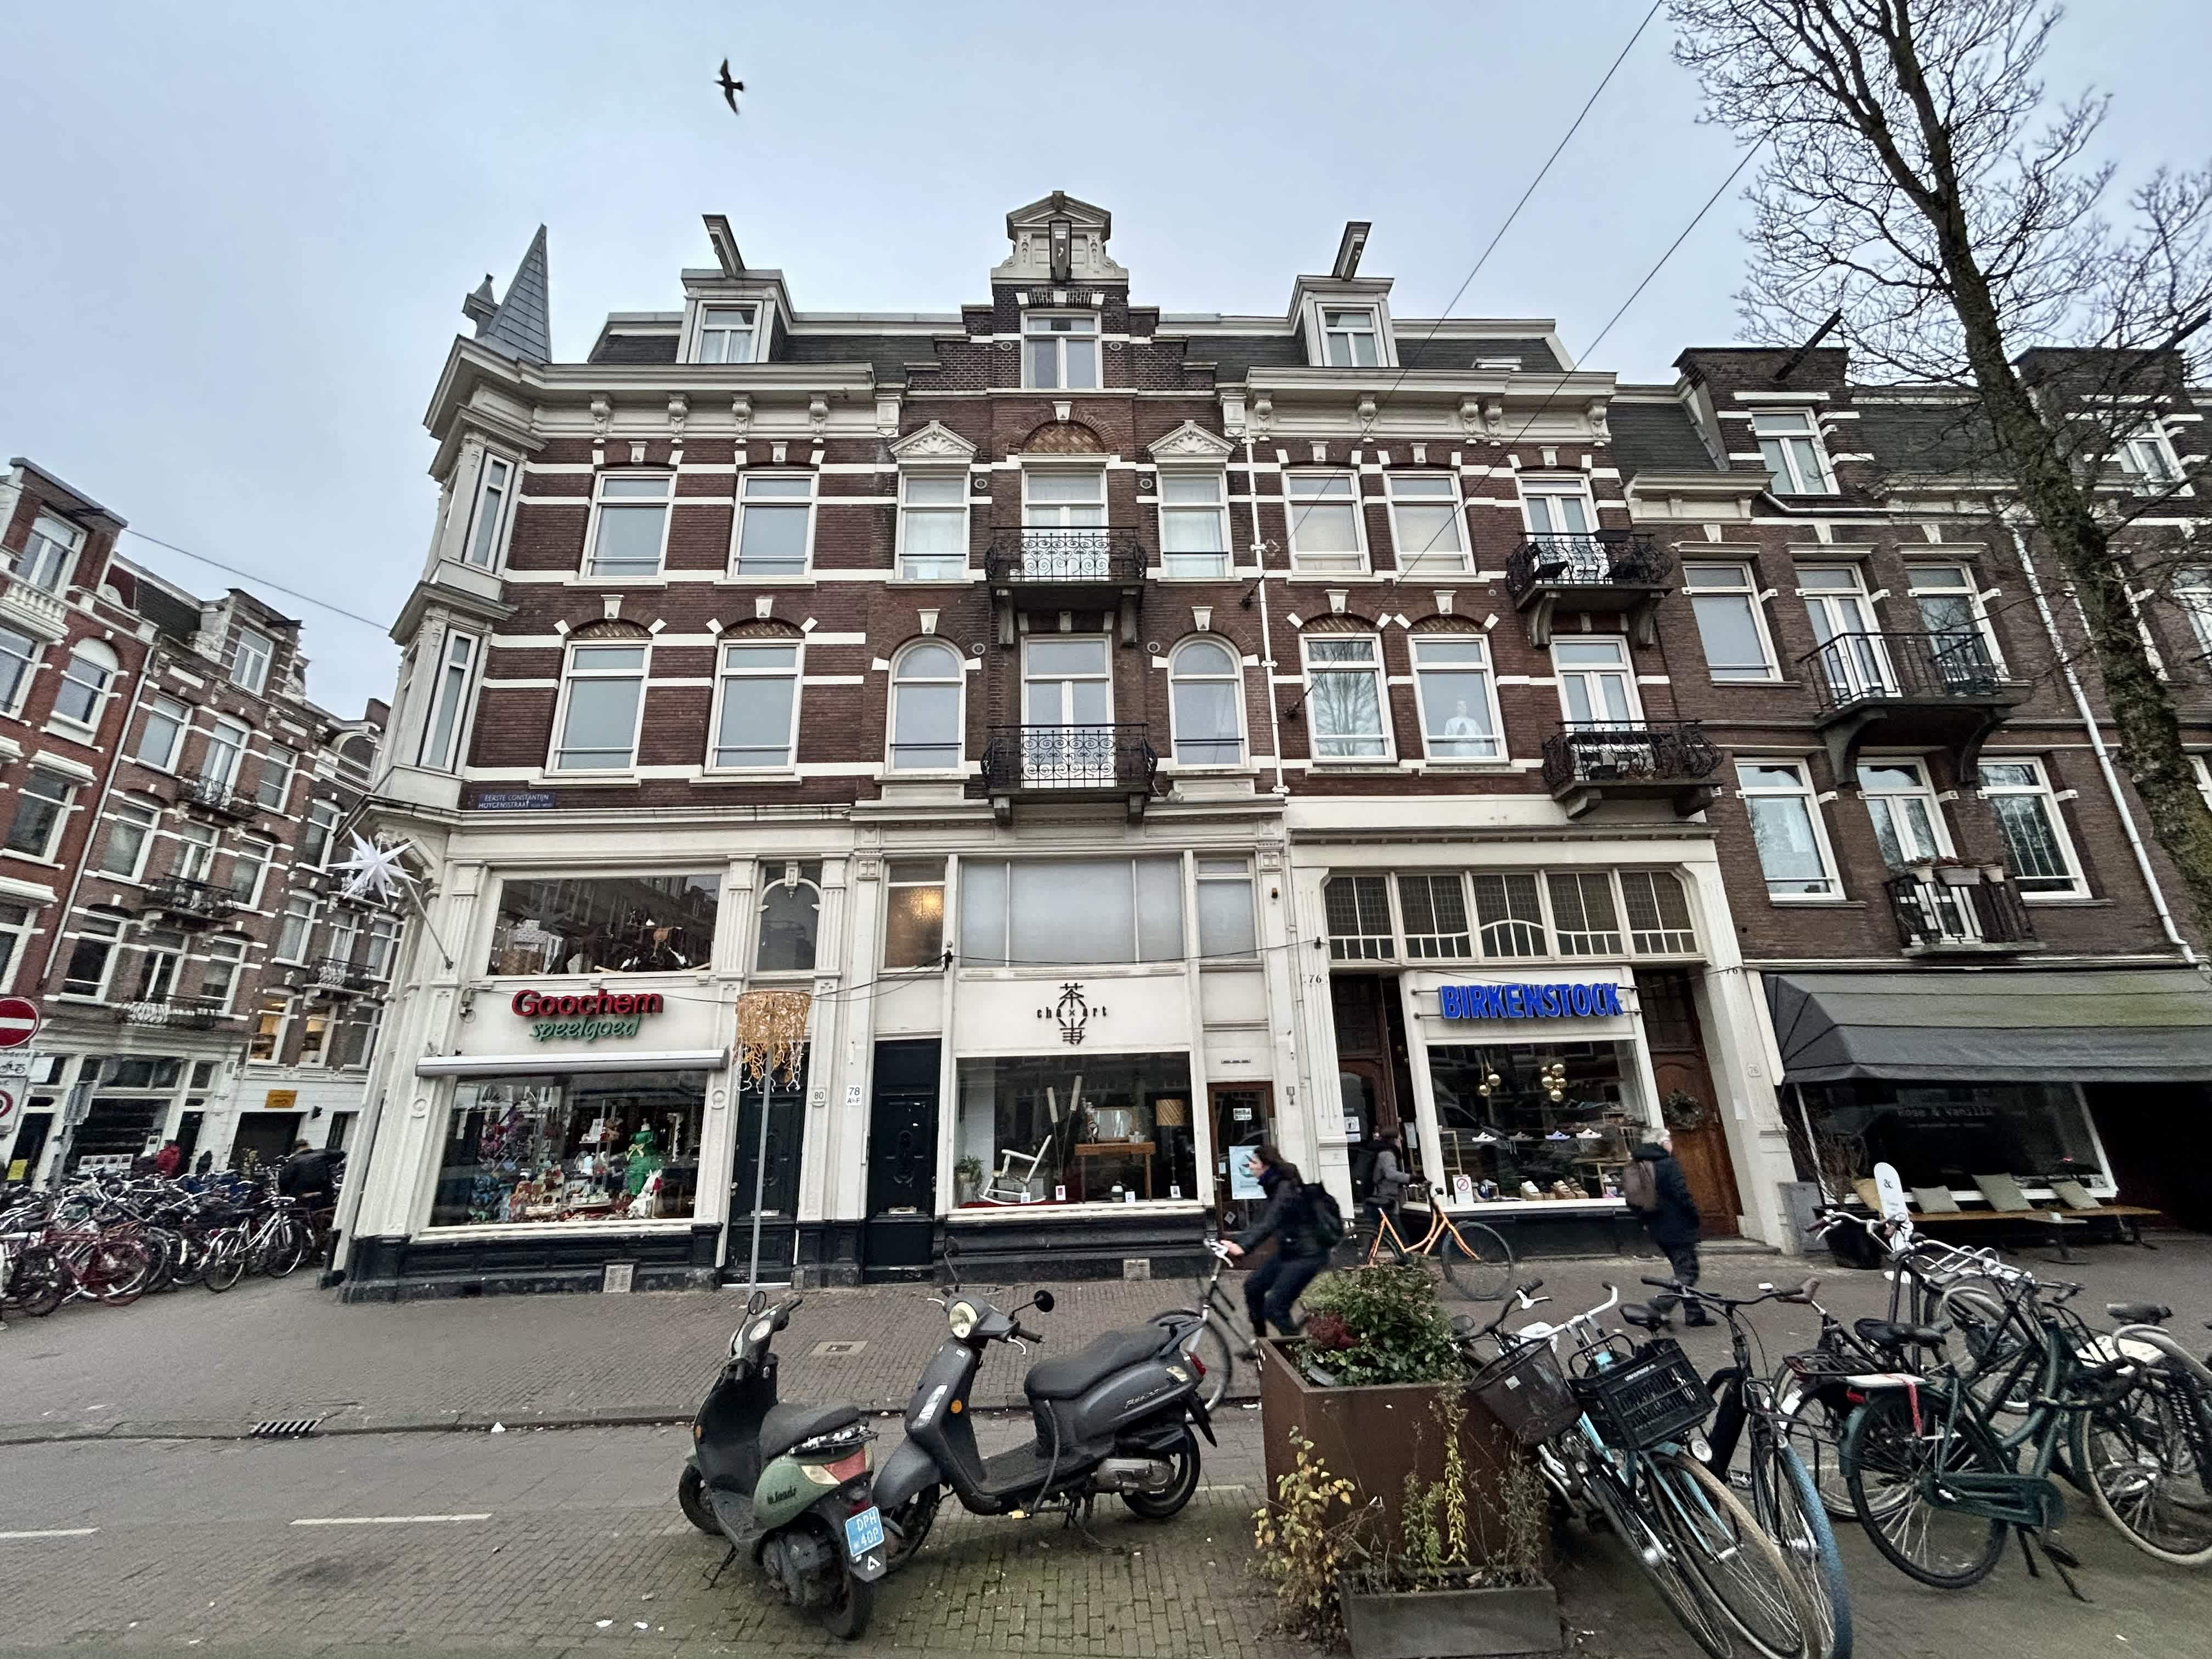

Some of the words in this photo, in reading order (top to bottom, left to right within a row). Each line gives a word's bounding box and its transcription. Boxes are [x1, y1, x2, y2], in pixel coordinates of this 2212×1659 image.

[1309, 974, 1322, 983] 76
[512, 988, 664, 1017] Goochem
[1438, 983, 1624, 1019] BIRKENSTOCK
[1037, 1006, 1062, 1019] cha
[1082, 1006, 1107, 1017] art
[529, 1014, 641, 1042] speelgoed
[849, 1087, 860, 1096] 78
[856, 1511, 877, 1532] DPH
[860, 1528, 879, 1546] 40P
